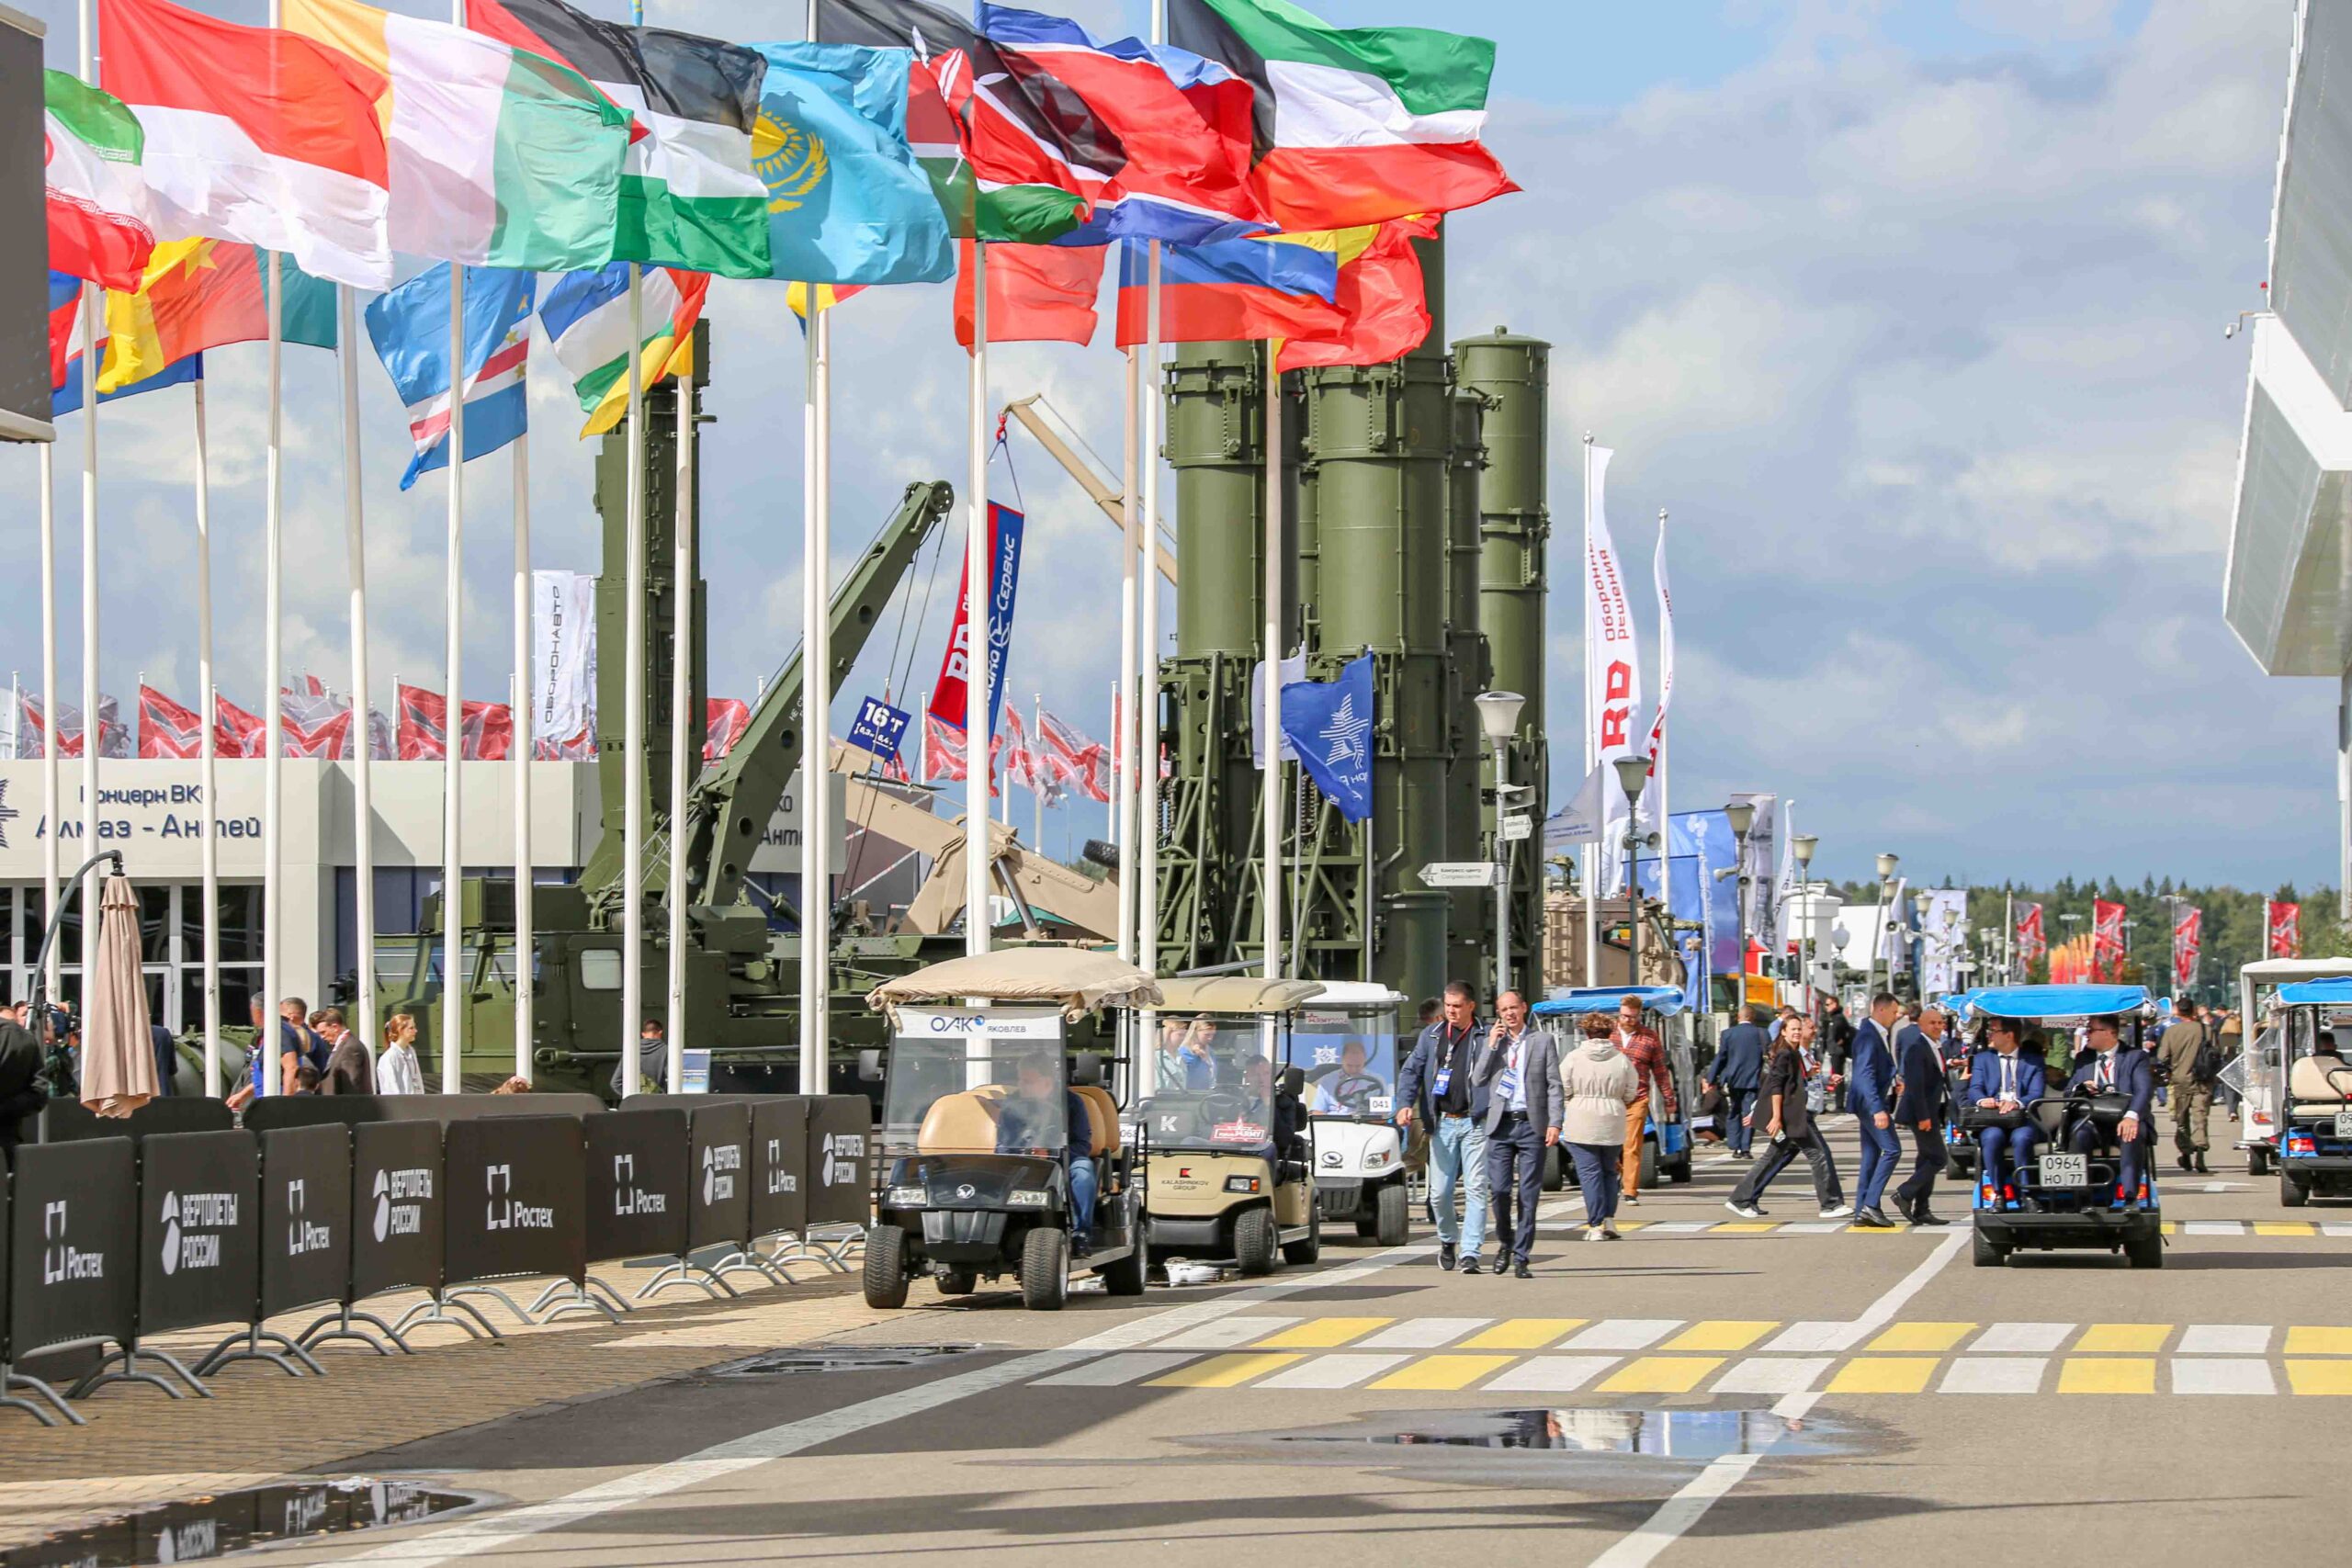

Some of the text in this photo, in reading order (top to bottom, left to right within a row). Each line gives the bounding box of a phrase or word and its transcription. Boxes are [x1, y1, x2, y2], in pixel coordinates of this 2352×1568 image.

[171, 784, 204, 803] ВК
[987, 1025, 1027, 1033] ЯКОВЛЕВ
[1372, 1100, 1389, 1109] 041
[2045, 1156, 2082, 1171] 0964
[2069, 1173, 2084, 1185] 77
[182, 1193, 238, 1228] ВЕРТОЛЕТЫ
[636, 1189, 667, 1214] Ростех
[390, 1204, 421, 1235] РОССИИ
[514, 1201, 554, 1229] Ростех
[305, 1221, 331, 1251] Ростех
[67, 1246, 104, 1280] Ростех
[182, 1235, 220, 1269] РОССИИ
